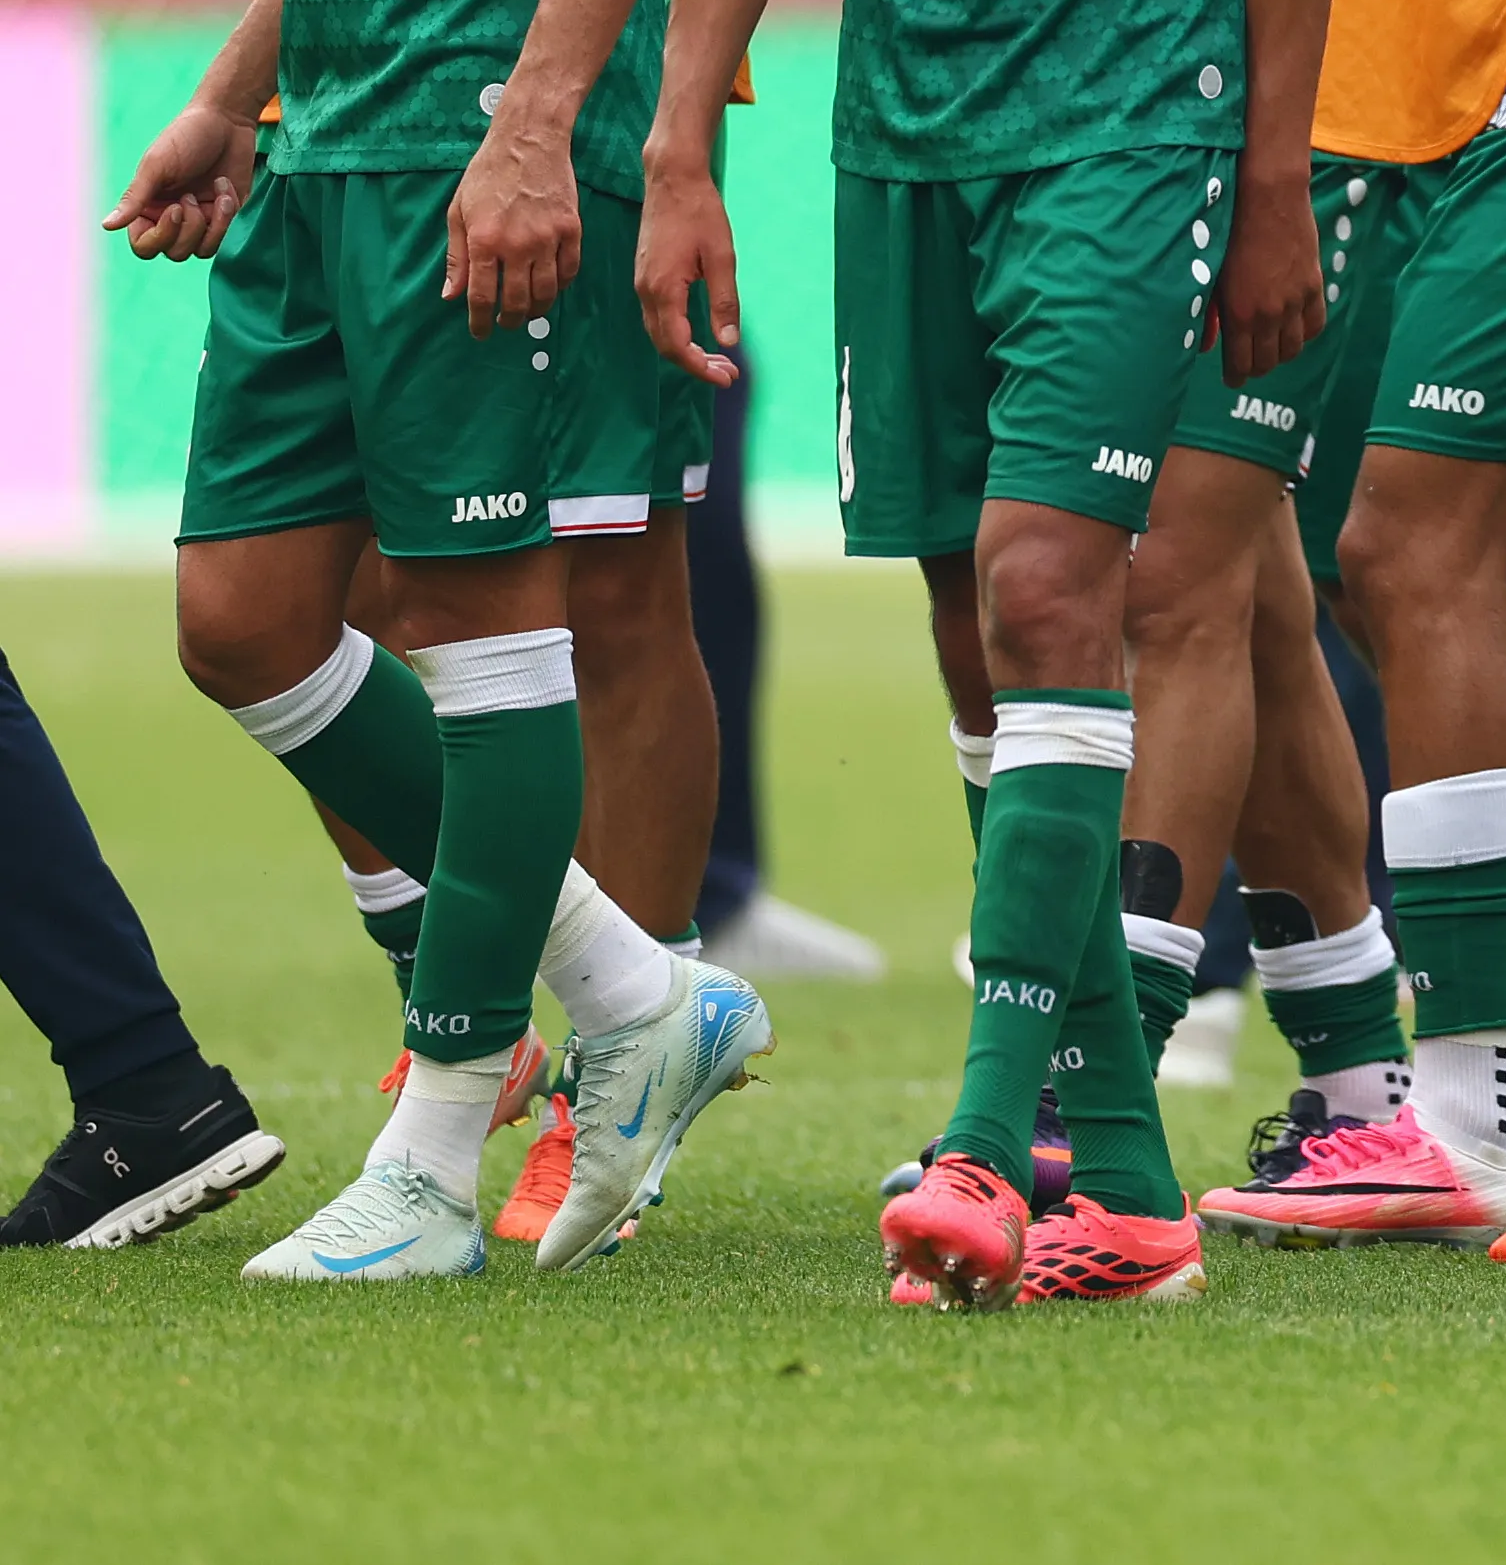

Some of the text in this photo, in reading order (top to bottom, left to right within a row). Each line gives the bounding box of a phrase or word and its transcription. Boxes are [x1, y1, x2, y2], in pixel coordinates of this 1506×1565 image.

[1230, 393, 1297, 433] JAKO
[1409, 382, 1486, 417] JAKO
[1091, 444, 1153, 485] JAKO
[450, 491, 528, 524] JAKO
[978, 979, 1057, 1014] JAKO
[405, 999, 472, 1036] AKO
